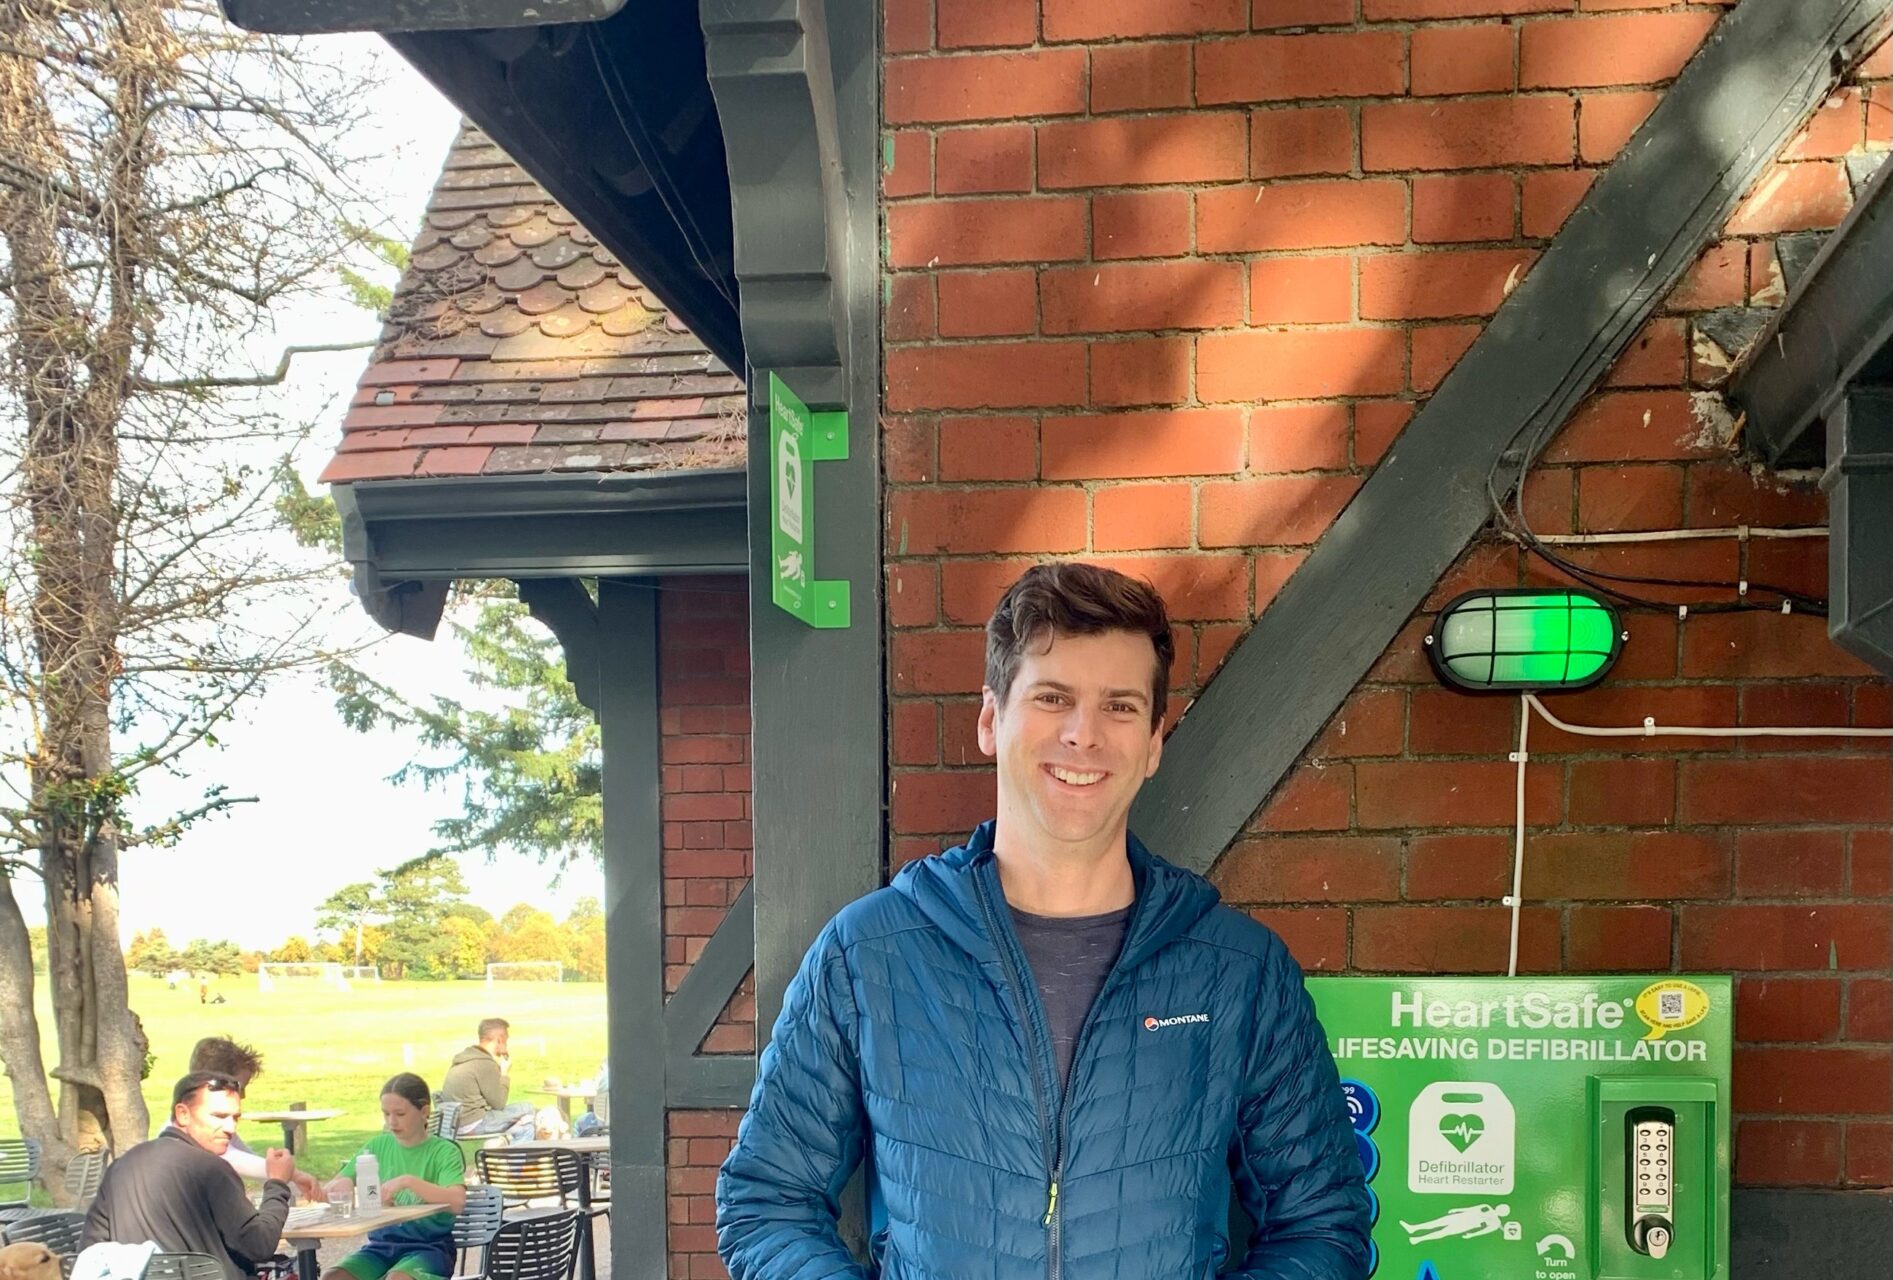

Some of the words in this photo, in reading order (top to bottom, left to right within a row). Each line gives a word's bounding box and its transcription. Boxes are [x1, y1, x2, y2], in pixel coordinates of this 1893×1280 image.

[1391, 991, 1625, 1029] HeartSafe
[1158, 1013, 1209, 1027] MONTANE
[1487, 1038, 1708, 1062] DEFIBRILLATOR
[1341, 1086, 1355, 1094] 99
[1419, 1160, 1505, 1174] Defibrillator
[1418, 1174, 1449, 1184] Heart
[1452, 1175, 1505, 1185] Restarter
[1544, 1257, 1567, 1267] Turn
[1536, 1270, 1547, 1279] to
[1549, 1272, 1576, 1280] open
